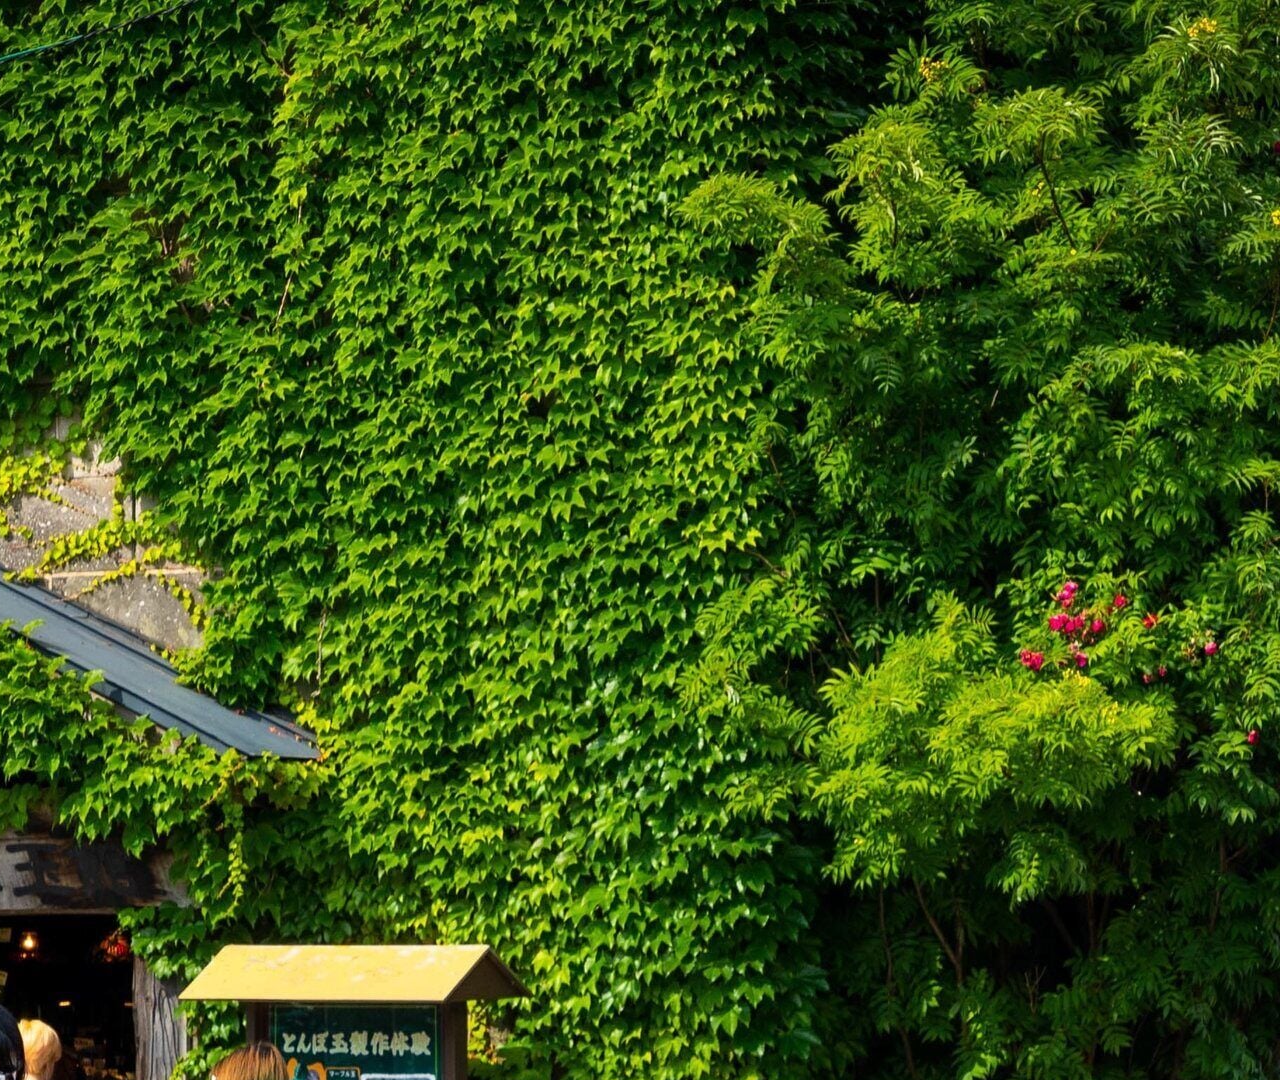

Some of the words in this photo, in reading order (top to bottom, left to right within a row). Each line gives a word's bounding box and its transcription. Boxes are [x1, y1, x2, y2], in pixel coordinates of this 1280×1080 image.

[281, 1031, 432, 1057] とんぼ玉製作体験
